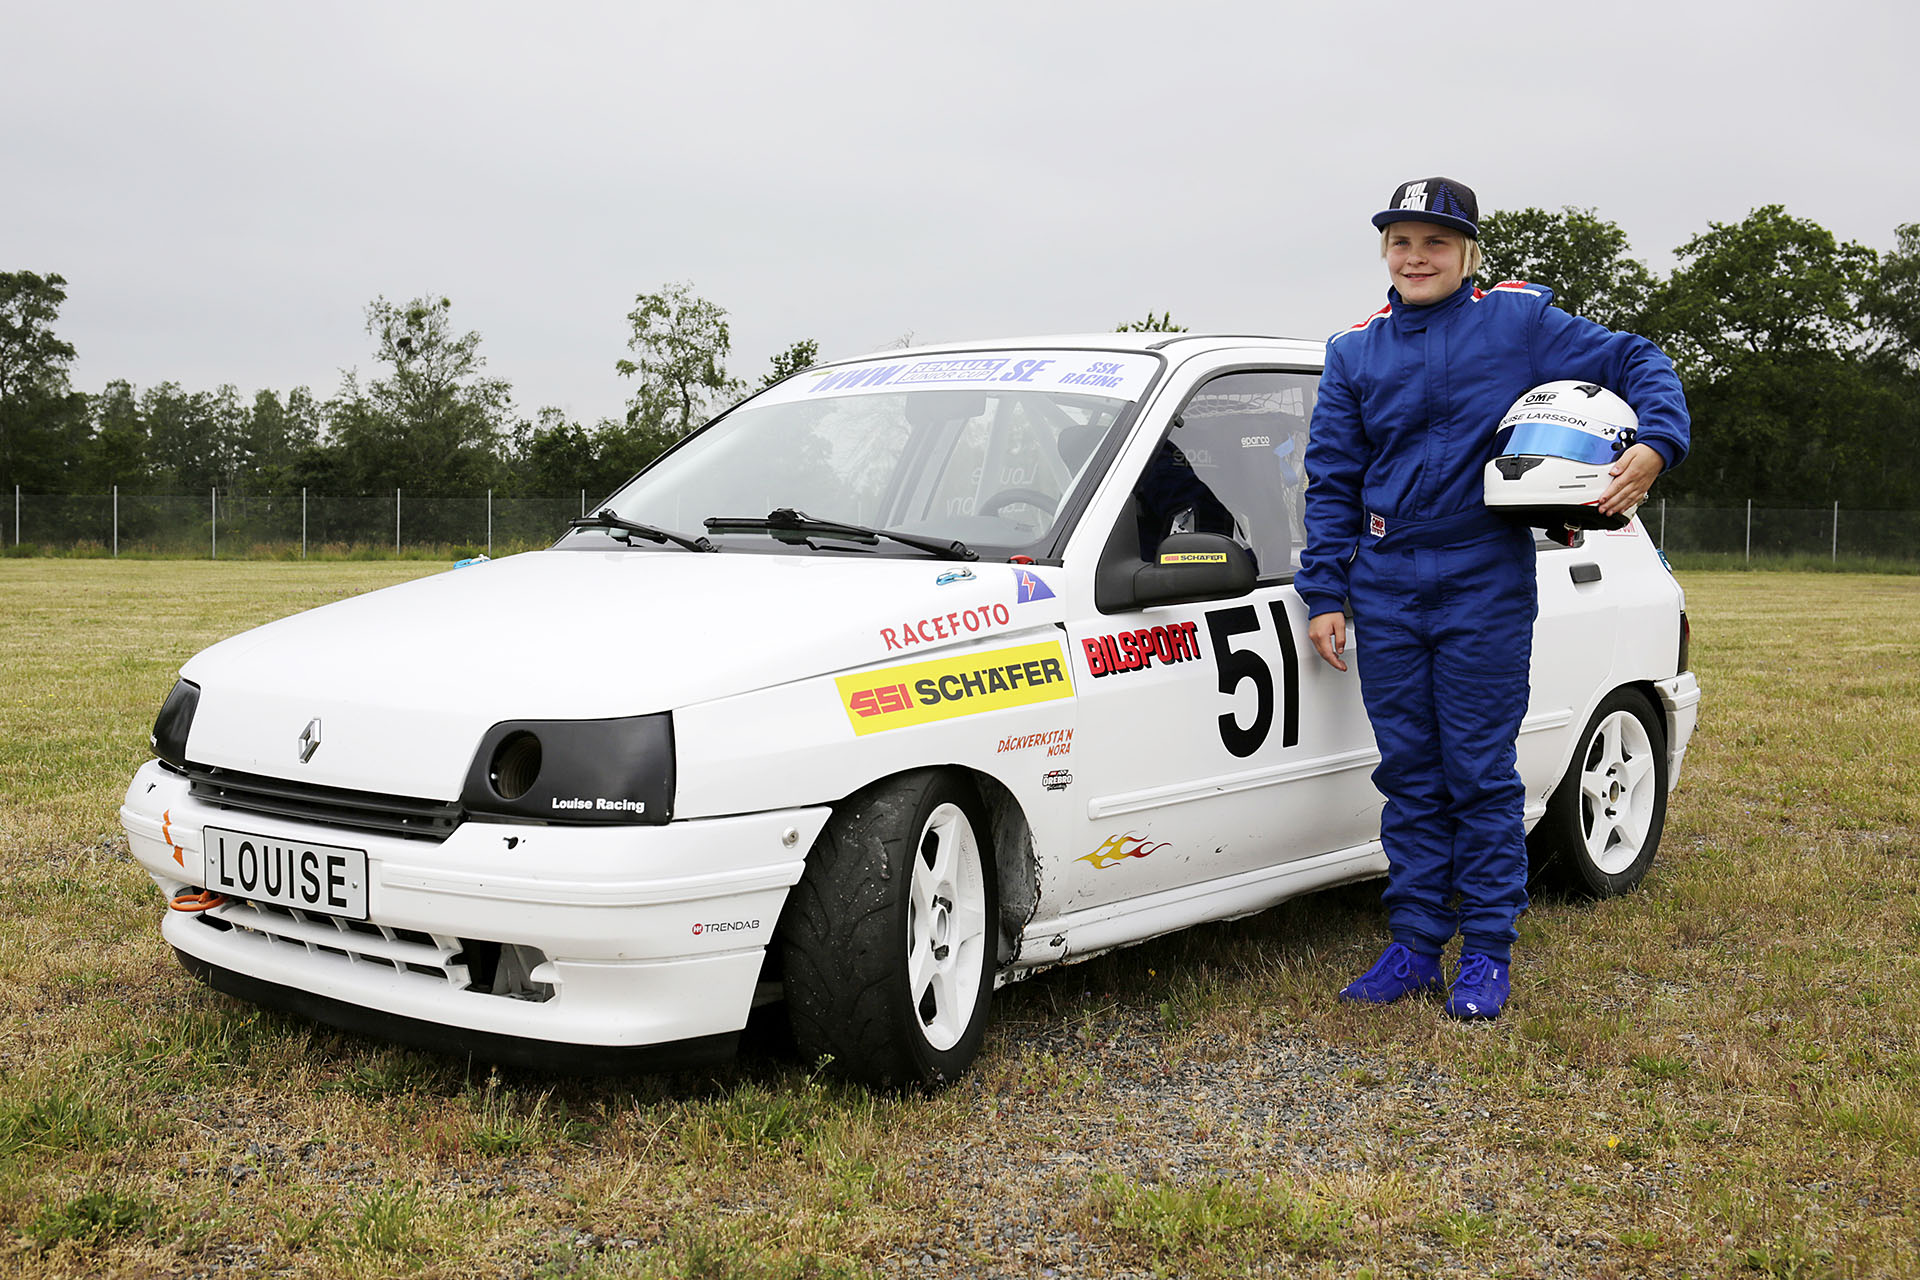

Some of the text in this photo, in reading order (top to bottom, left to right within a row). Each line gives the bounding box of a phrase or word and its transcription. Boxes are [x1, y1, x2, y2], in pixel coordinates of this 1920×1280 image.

[913, 360, 1001, 372] RENAULT
[959, 369, 992, 379] CUP
[1086, 361, 1126, 375] SSK
[1058, 372, 1124, 388] RACING
[1525, 393, 1557, 403] OMP
[1526, 412, 1588, 427] LARSSON
[879, 603, 1010, 651] RACEFOTO
[1081, 621, 1202, 678] BILSPORT
[849, 657, 1065, 717] SSI SCHÄFER
[1204, 600, 1299, 758] 51
[1047, 742, 1071, 758] NORA
[552, 797, 645, 813] Louise Racing
[219, 837, 347, 908] LOUISE
[704, 919, 760, 932] TRENDAB
